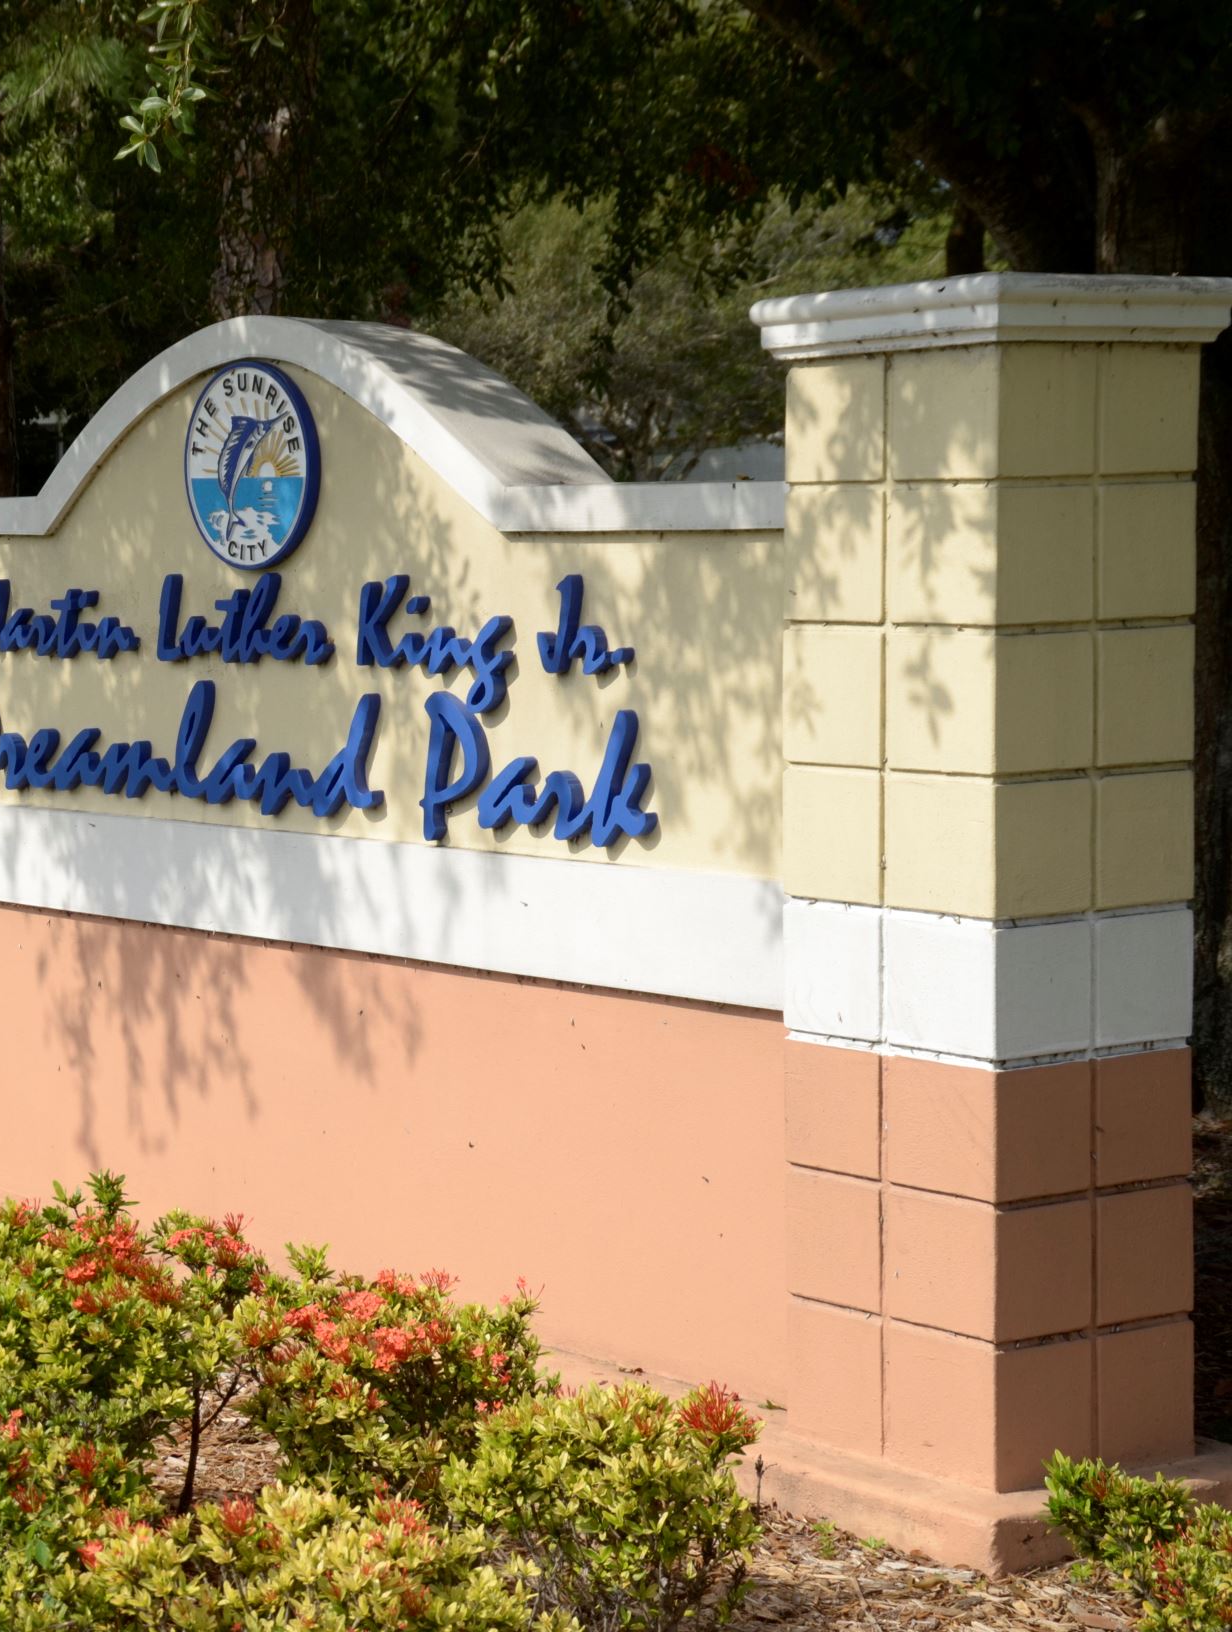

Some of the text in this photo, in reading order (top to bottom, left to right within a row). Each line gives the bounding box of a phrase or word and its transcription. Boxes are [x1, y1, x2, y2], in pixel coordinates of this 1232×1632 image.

[192, 372, 300, 457] THE SUNRISE
[228, 539, 268, 561] CITY
[156, 572, 335, 666] Luther
[356, 574, 514, 714] King
[419, 691, 658, 847] Park
